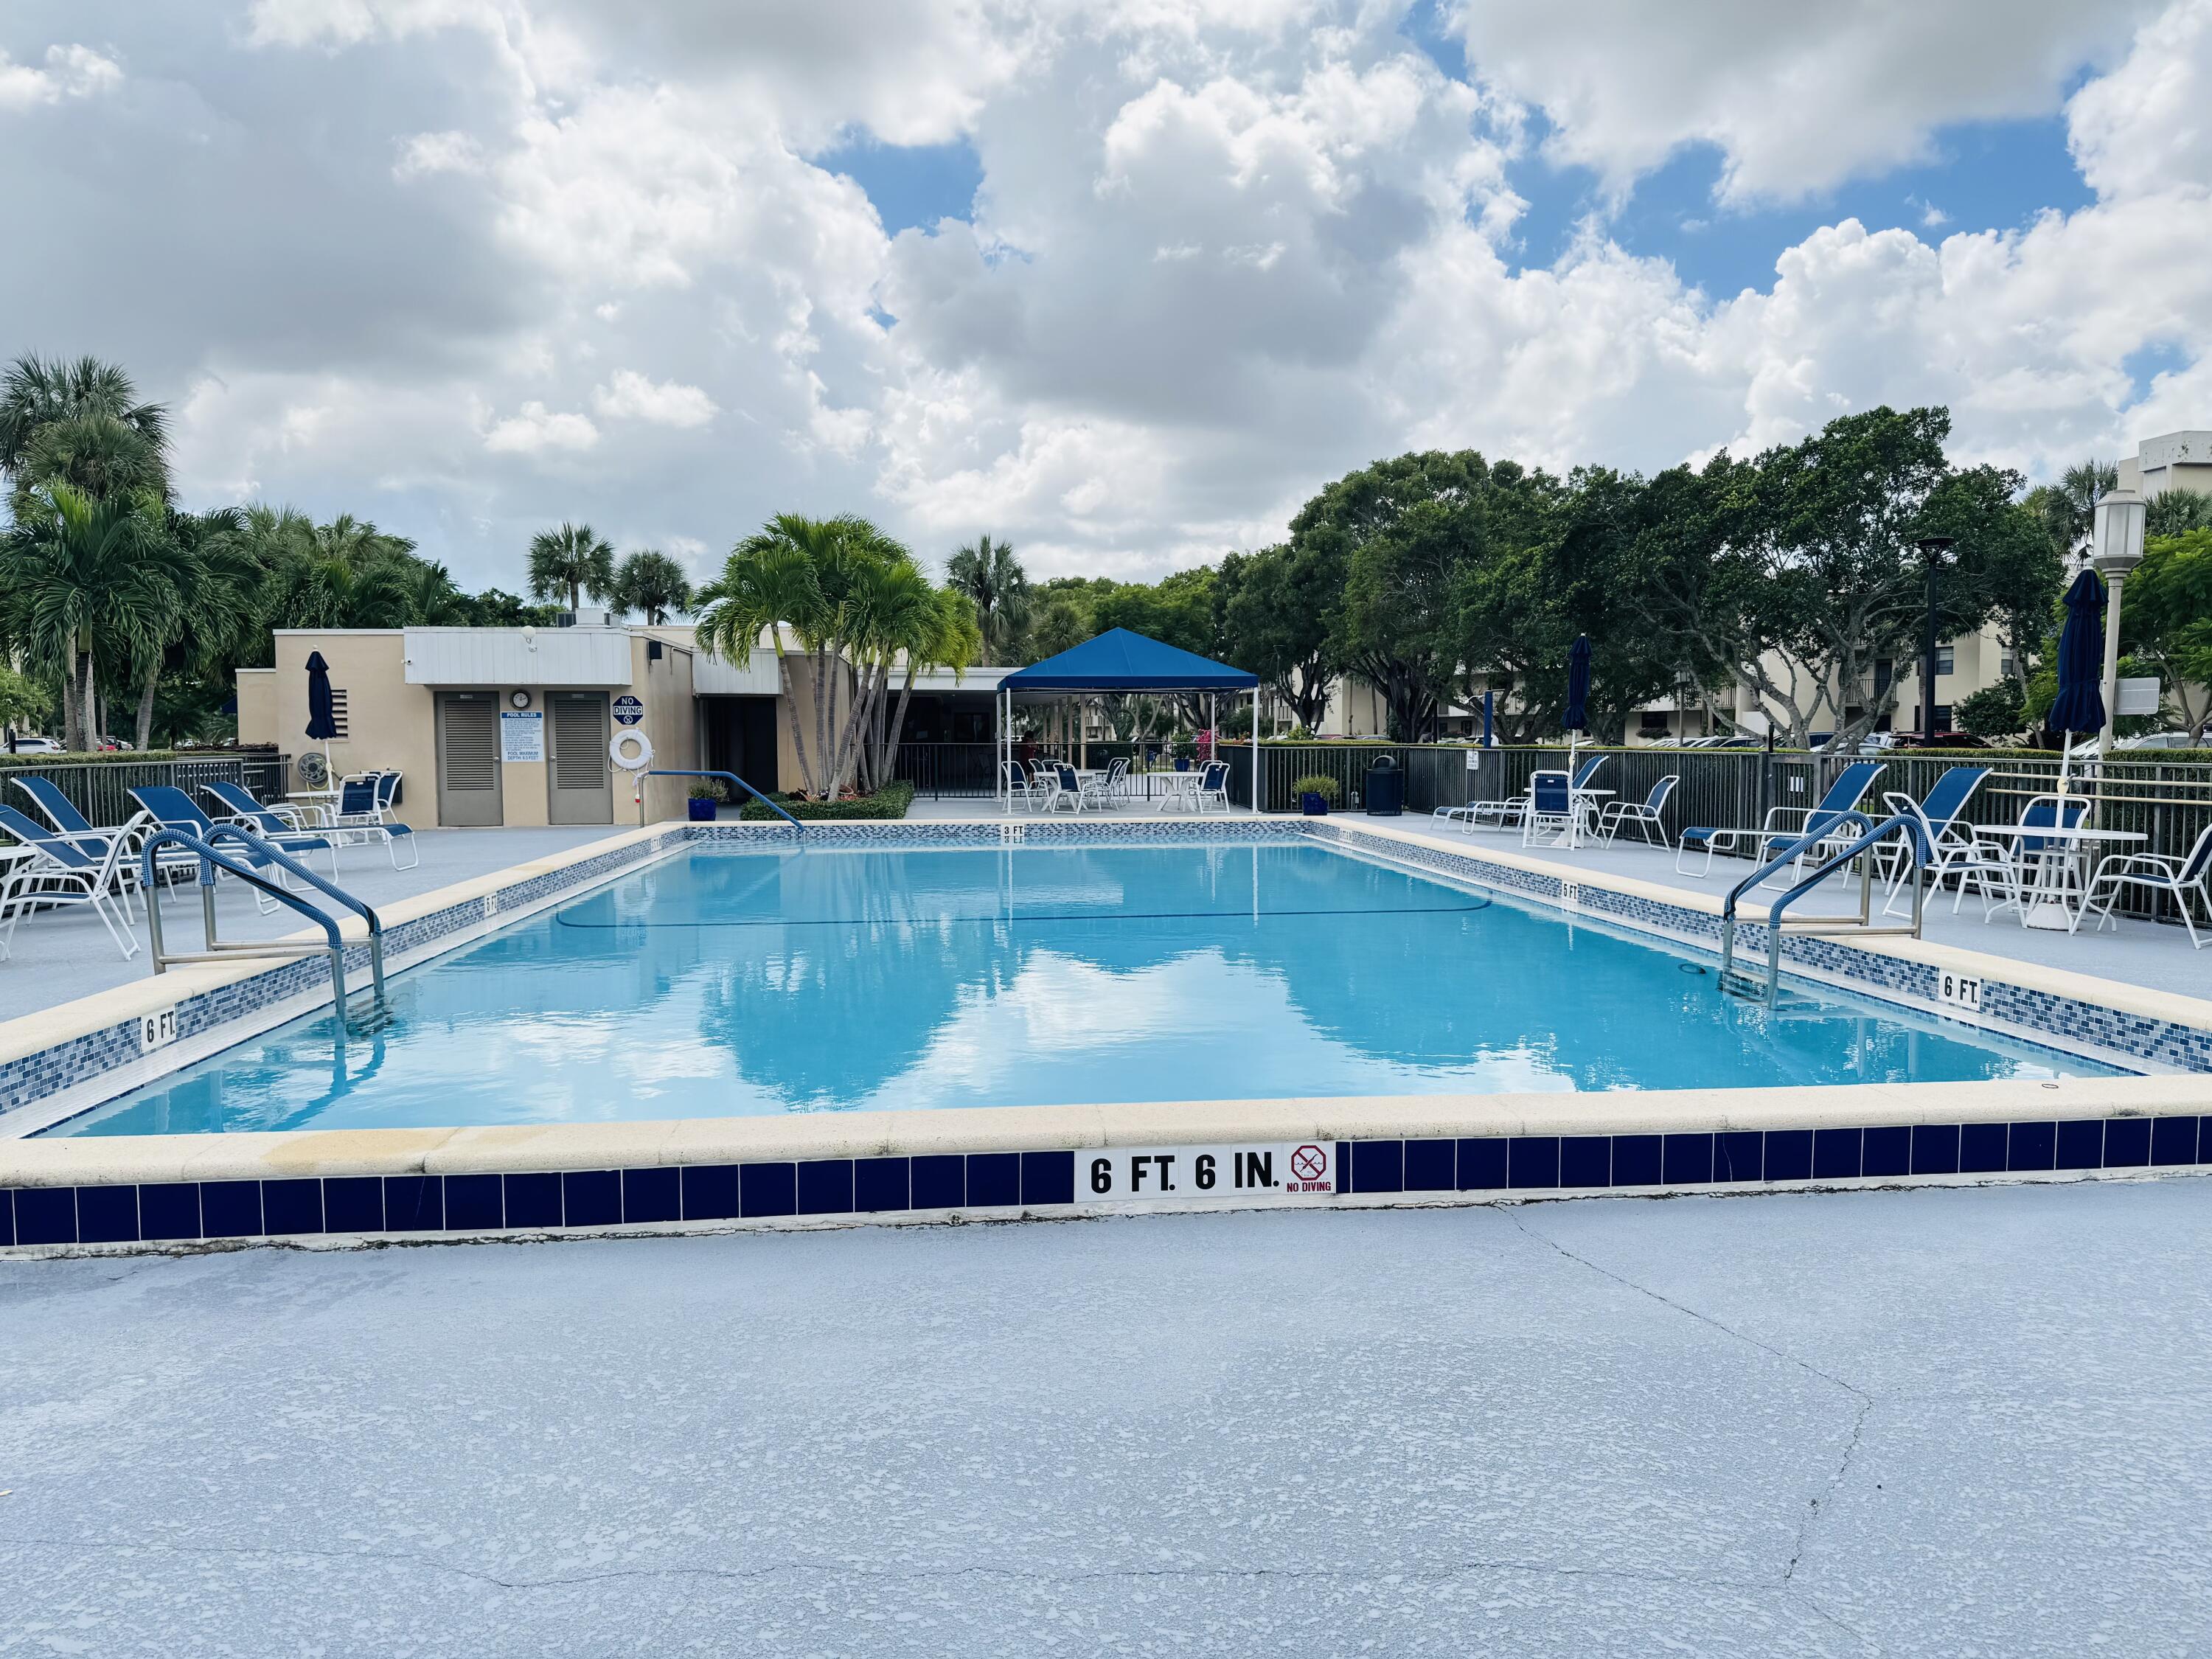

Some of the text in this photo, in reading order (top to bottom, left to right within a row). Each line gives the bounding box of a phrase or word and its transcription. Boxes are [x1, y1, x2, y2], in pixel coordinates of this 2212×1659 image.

[622, 697, 634, 705] NO
[1564, 883, 1568, 897] 5
[487, 897, 490, 911] 5
[1944, 975, 1978, 1004] 6 FT.
[146, 1011, 175, 1043] 6 FT.
[1091, 1152, 1279, 1194] 6 FT. 6 IN.
[1287, 1182, 1332, 1192] NO DIVING
